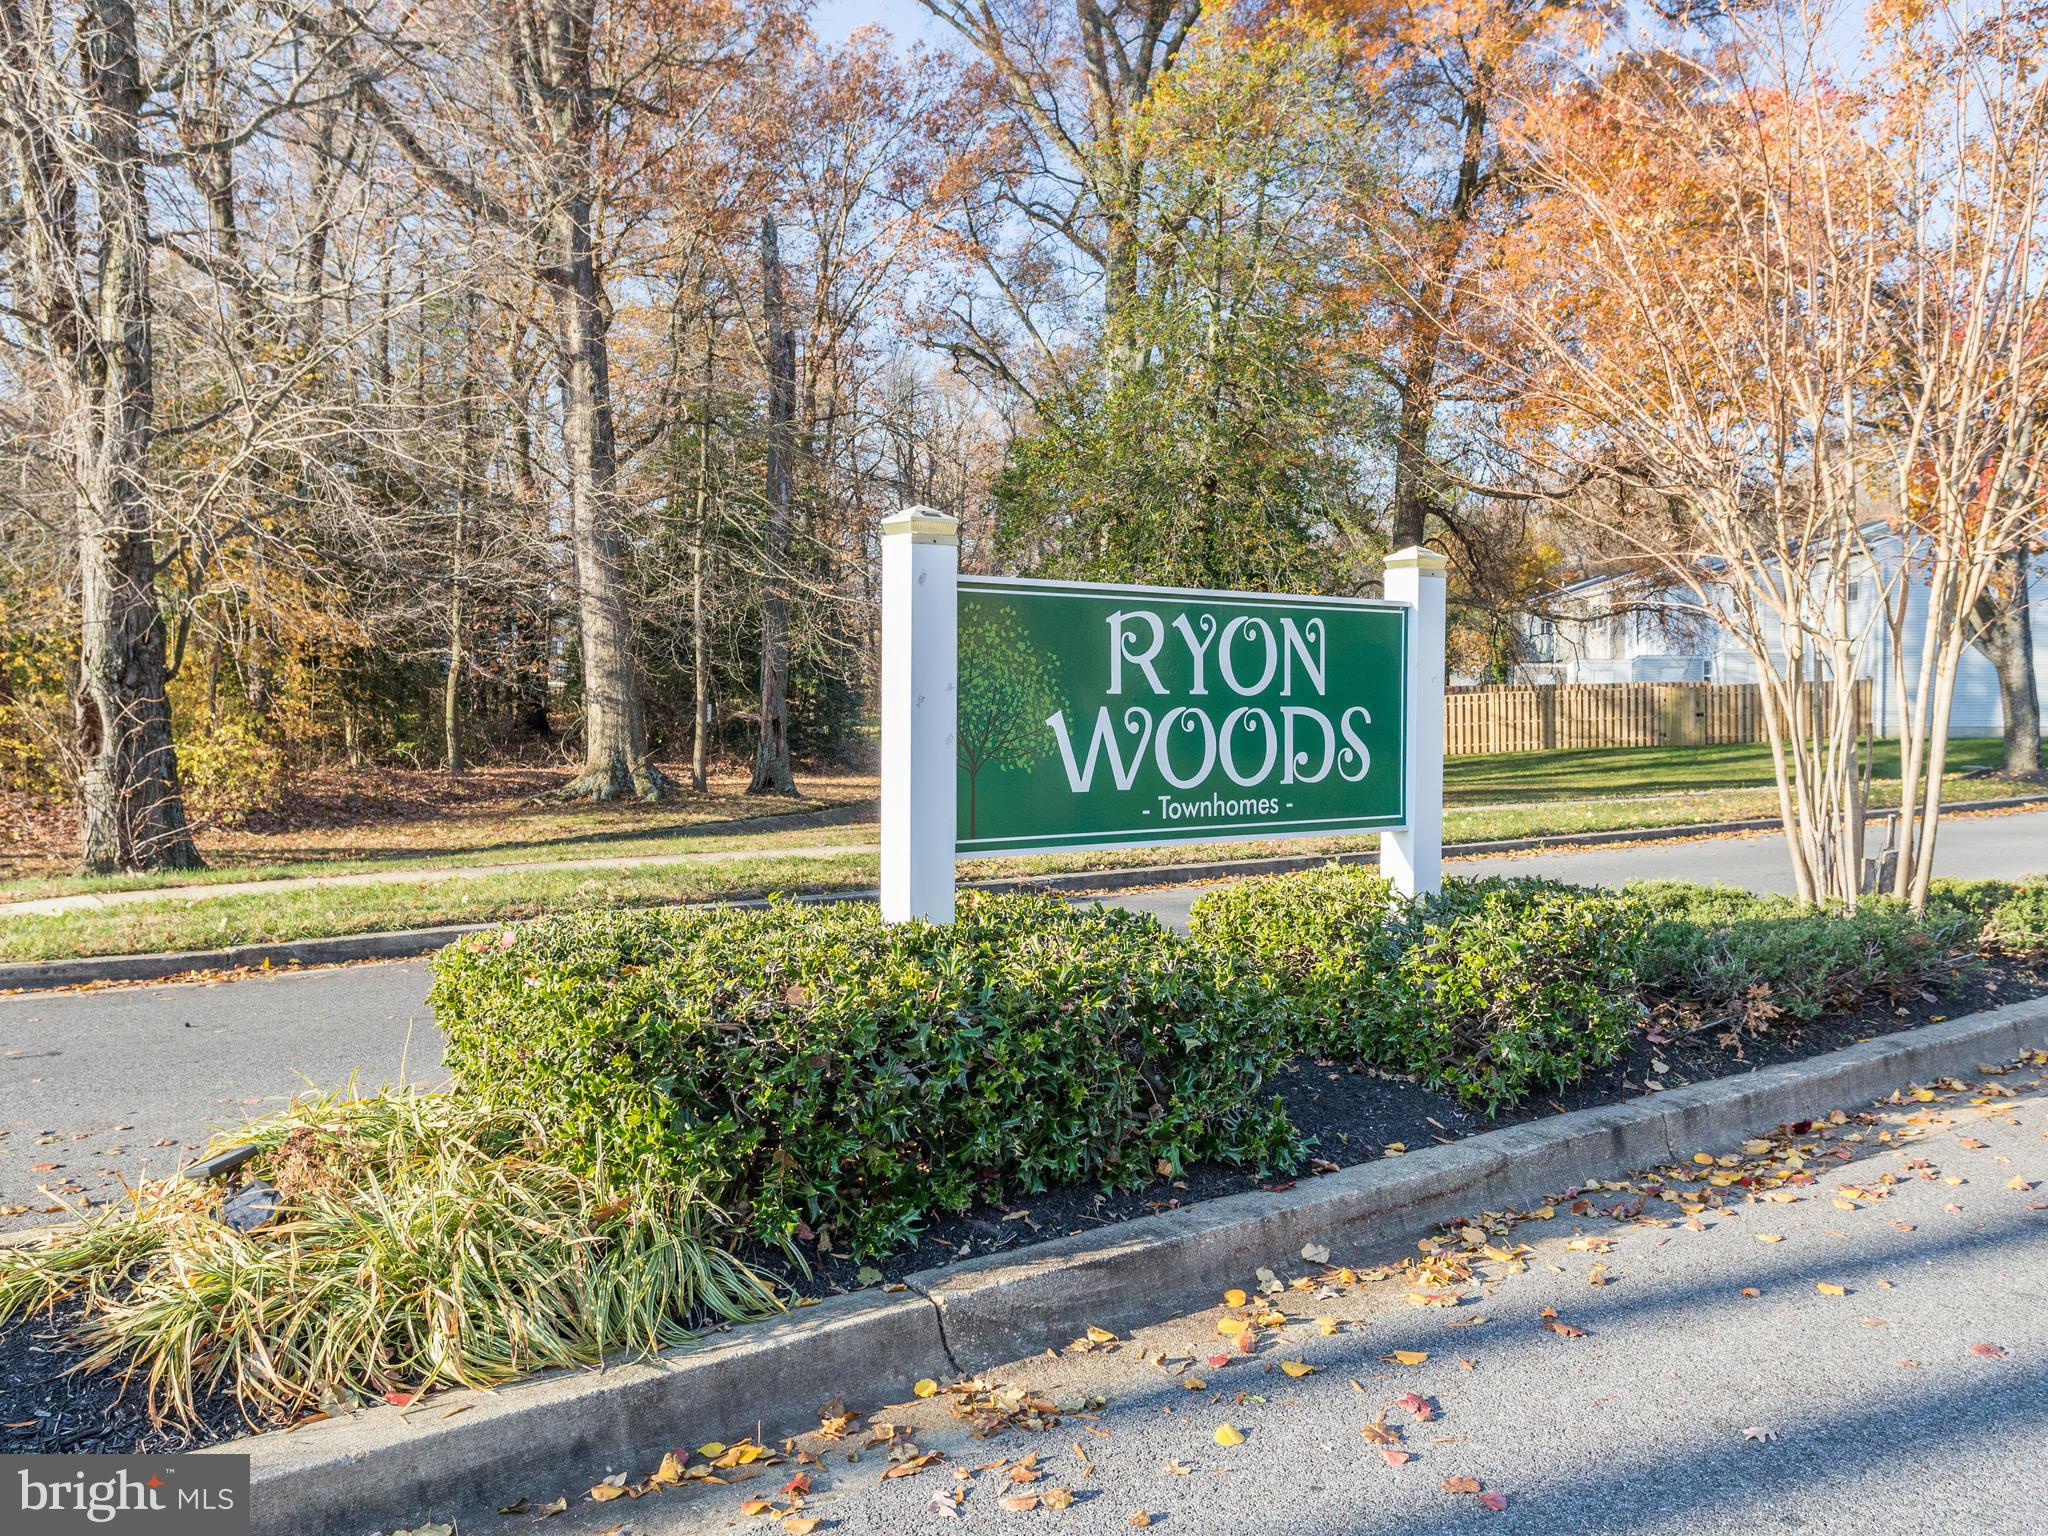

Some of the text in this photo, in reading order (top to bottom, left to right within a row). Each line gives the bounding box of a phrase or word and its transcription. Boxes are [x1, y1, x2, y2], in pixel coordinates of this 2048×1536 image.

[1105, 610, 1326, 697] RYON
[1045, 705, 1372, 793] WOODS
[1158, 792, 1279, 820] Townhomes
